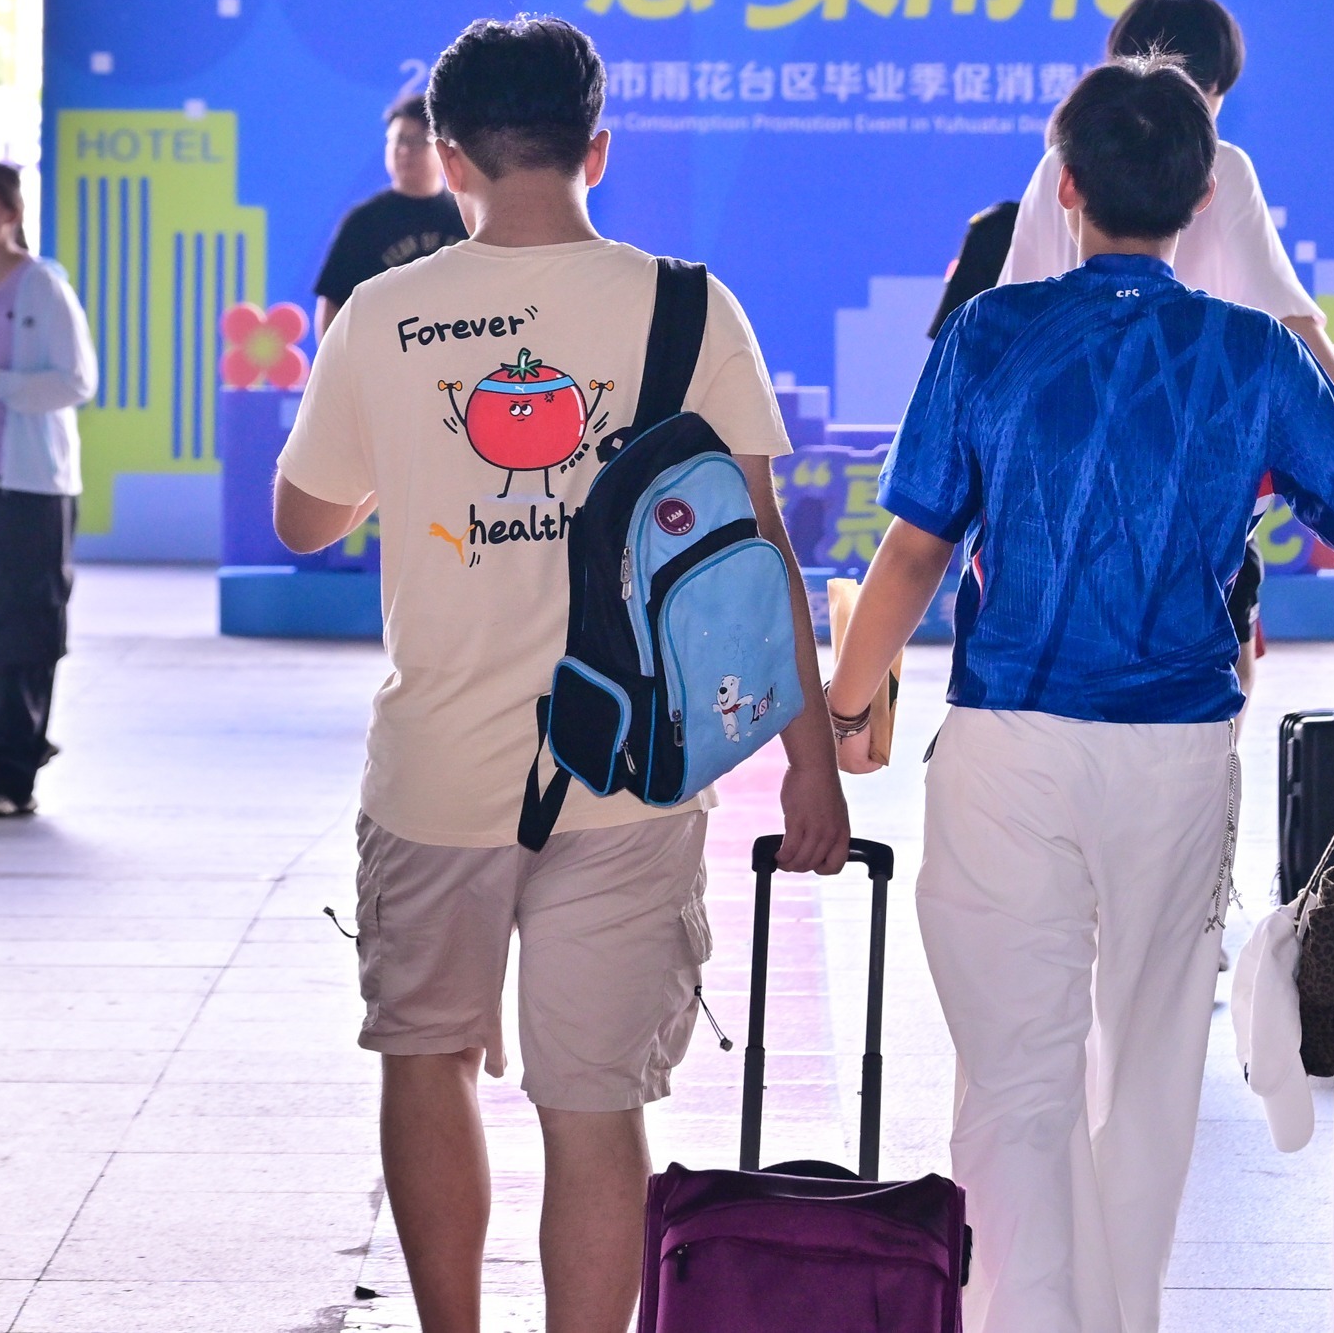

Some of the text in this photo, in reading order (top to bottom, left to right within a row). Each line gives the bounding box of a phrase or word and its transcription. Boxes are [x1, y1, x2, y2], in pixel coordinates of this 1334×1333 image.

[608, 61, 1091, 103] 市雨花台区毕业季促消费
[76, 128, 223, 164] HOTEL
[1116, 288, 1140, 298] CFC
[397, 316, 525, 353] Forever
[470, 502, 579, 545] health
